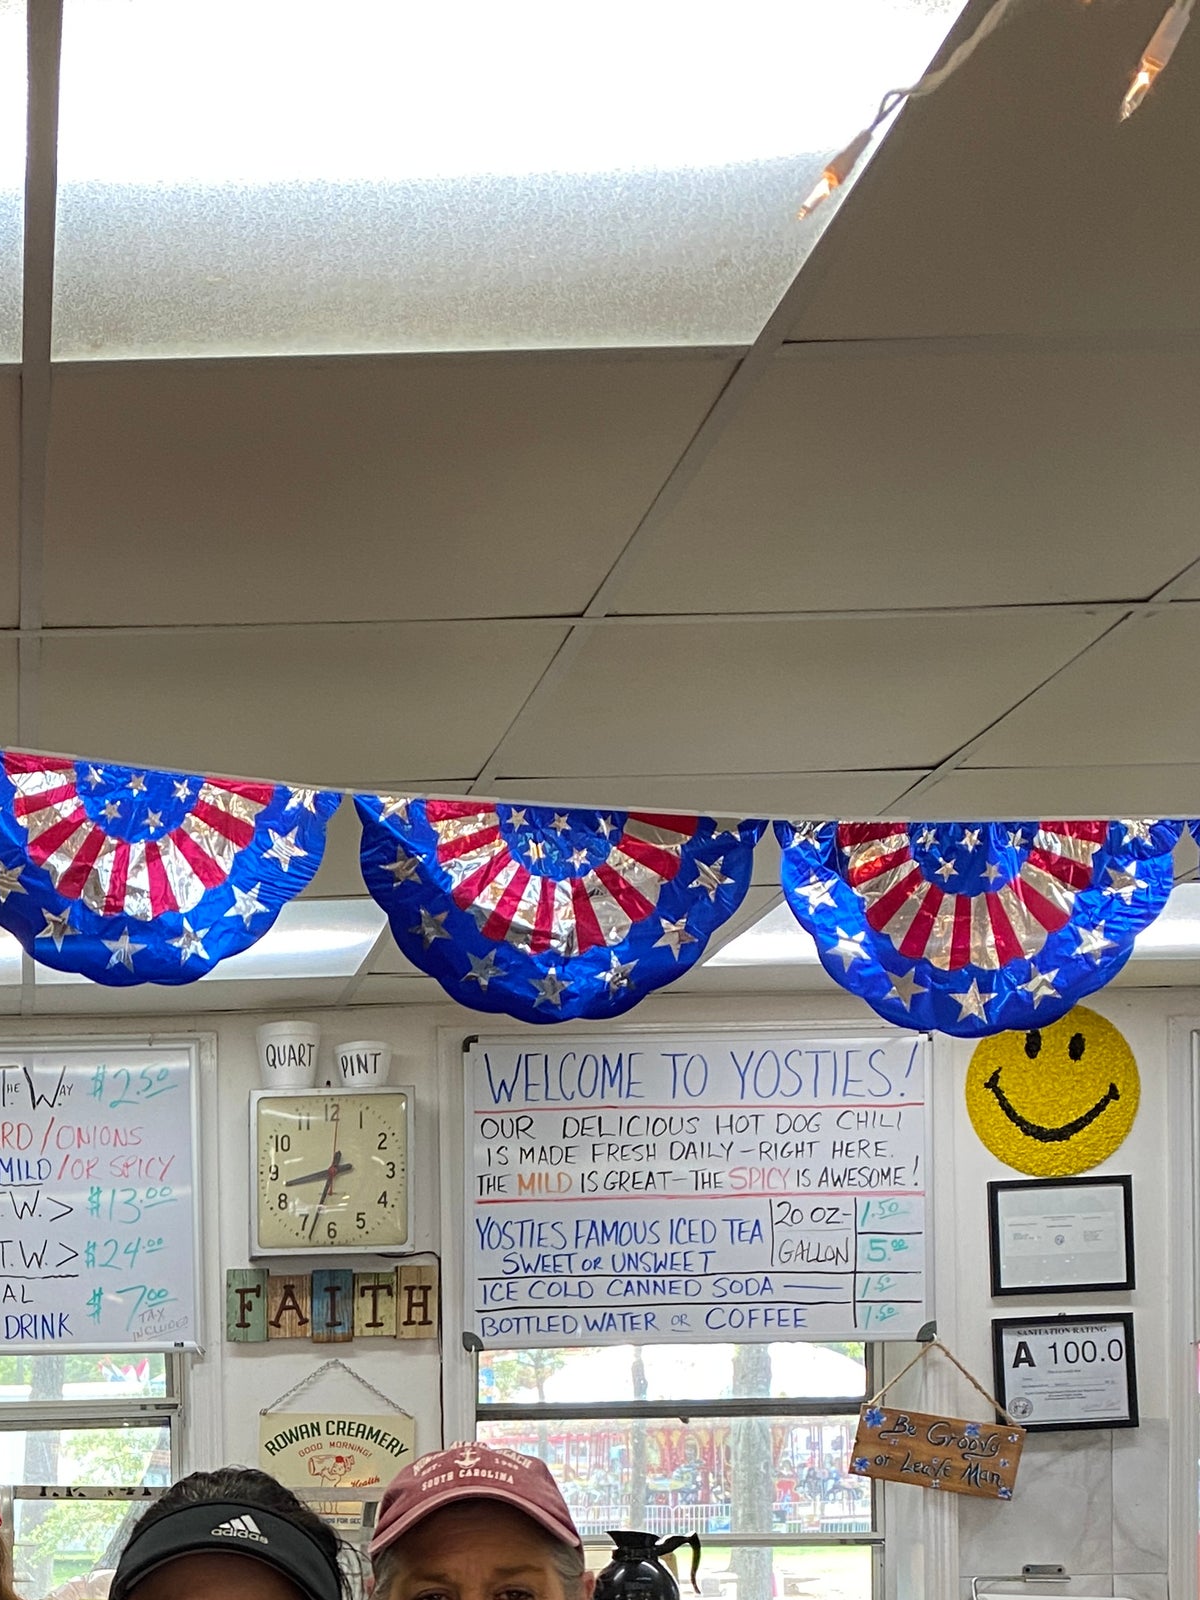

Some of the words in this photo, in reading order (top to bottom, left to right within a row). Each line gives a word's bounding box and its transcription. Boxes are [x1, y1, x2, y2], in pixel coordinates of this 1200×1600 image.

[265, 1043, 315, 1068] QUART
[340, 1052, 382, 1077] PINT
[484, 1051, 645, 1104] WELCOME
[661, 1052, 709, 1099] TO
[730, 1041, 918, 1100] YOSTIES!
[324, 1103, 340, 1122] 12
[358, 1110, 364, 1129] 1
[480, 1115, 536, 1140] OUR
[562, 1115, 700, 1140] DELICIOUS
[716, 1113, 765, 1135] HOT
[776, 1112, 822, 1134] DOG
[836, 1110, 901, 1130] CHILI
[274, 1134, 291, 1153] 10
[377, 1132, 388, 1150] 2
[487, 1145, 509, 1167] IS
[520, 1145, 578, 1166] MADE
[591, 1142, 656, 1163] FRESH
[109, 1154, 175, 1182] SPICY
[268, 1164, 279, 1181] 9
[386, 1161, 396, 1179] 3
[477, 1173, 512, 1196] THE
[517, 1171, 573, 1197] MILD
[581, 1170, 599, 1193] IS
[727, 1166, 792, 1191] SPICY
[796, 1168, 811, 1188] IS
[278, 1193, 288, 1210] 8
[377, 1191, 389, 1208] 4
[299, 1213, 309, 1231] 7
[327, 1222, 337, 1239] 6
[356, 1212, 366, 1230] 5
[475, 1216, 567, 1250] YOSTIES
[575, 1218, 661, 1249] FAMOUS
[670, 1217, 716, 1246] ICED
[722, 1218, 763, 1245] TEA
[774, 1201, 803, 1226] 20
[502, 1251, 577, 1275] SWEET
[611, 1250, 716, 1274] UNSWEET
[778, 1237, 849, 1267] GALLON
[483, 1280, 519, 1305] ICE
[528, 1279, 594, 1300] COLD
[606, 1278, 702, 1298] CANNED
[712, 1276, 773, 1298] SODA
[138, 1308, 166, 1323] TAX
[234, 1284, 433, 1329] FAITH
[5, 1312, 73, 1340] DRINK
[481, 1313, 578, 1338] BOTTLED
[584, 1311, 660, 1333] WATER
[671, 1313, 691, 1327] OR
[705, 1307, 808, 1331] COFFEE
[1017, 1326, 1071, 1336] SANITATION
[1073, 1325, 1107, 1334] RATING
[1012, 1341, 1037, 1368] A
[1048, 1338, 1123, 1365] 100.0
[264, 1421, 321, 1456] ROWAN
[325, 1420, 409, 1458] CREAMERY
[298, 1442, 323, 1458] GOOD
[329, 1441, 373, 1458] MORNING!
[879, 1414, 917, 1438] Be
[926, 1421, 1001, 1460] Groovy
[350, 1475, 380, 1488] Health
[421, 1471, 454, 1491] SOUTH
[459, 1468, 515, 1485] CAROLINA
[874, 1454, 891, 1466] or
[961, 1462, 1001, 1489] Man
[211, 1527, 269, 1545] adidas
